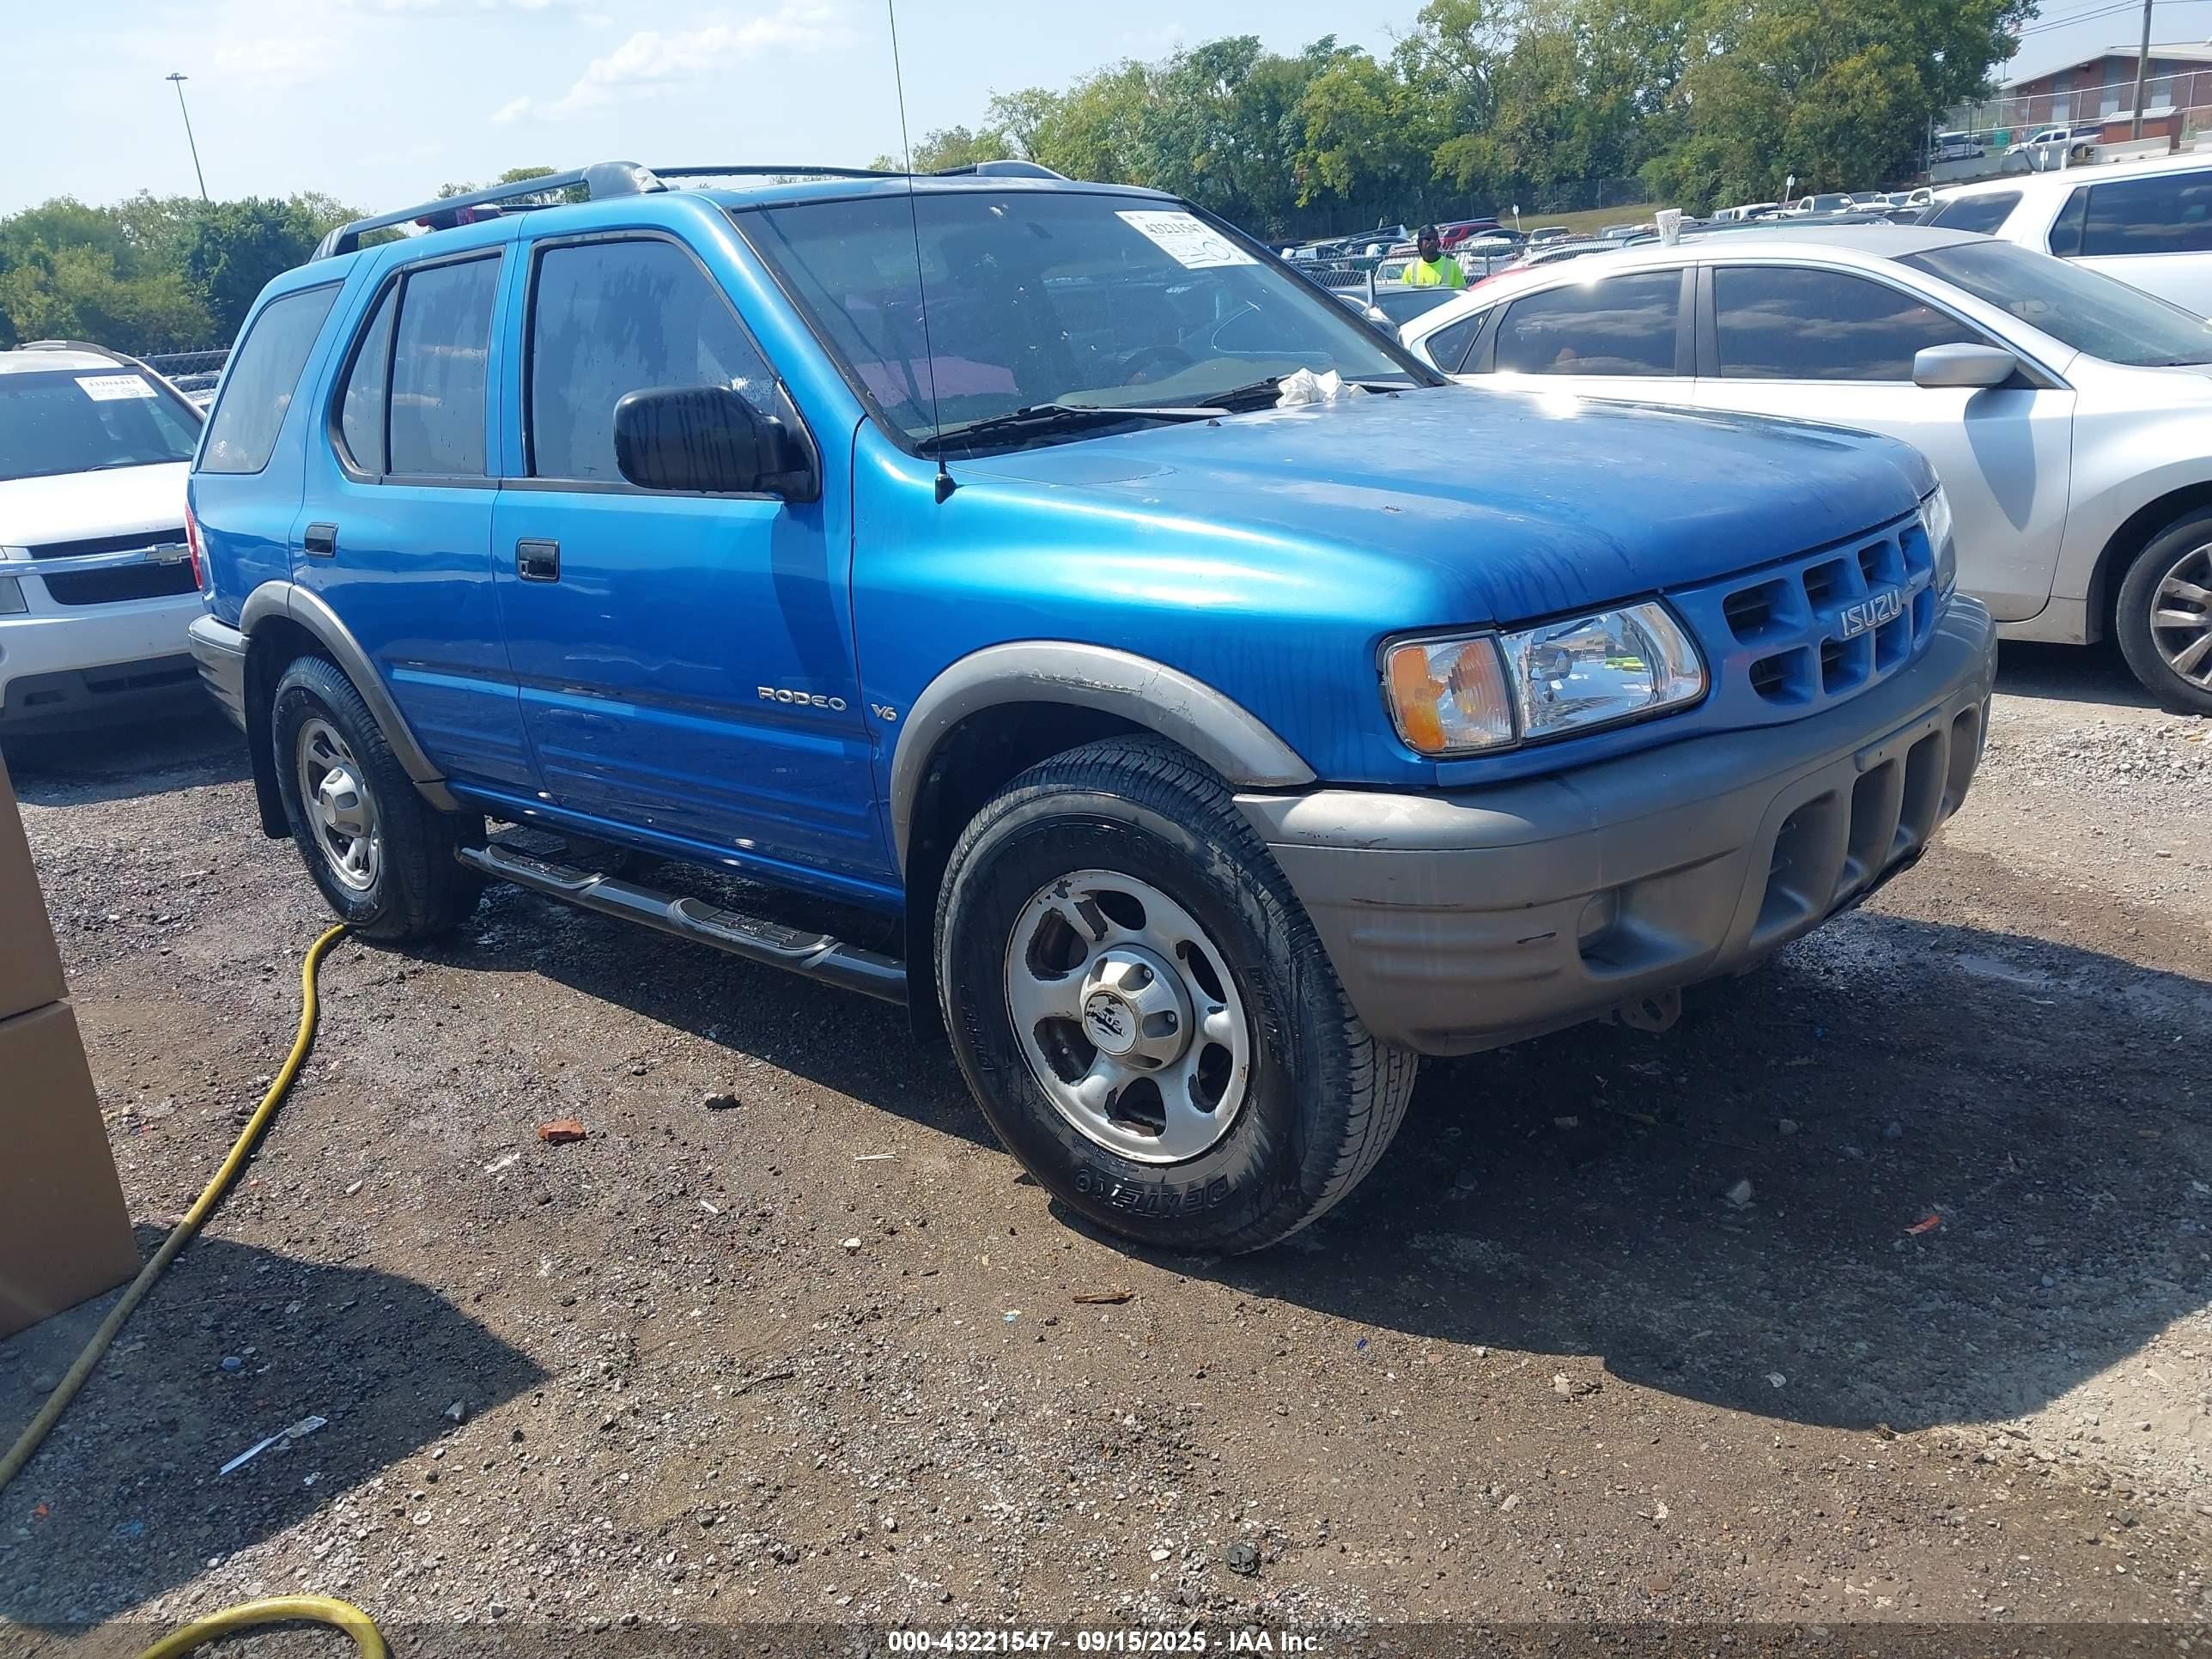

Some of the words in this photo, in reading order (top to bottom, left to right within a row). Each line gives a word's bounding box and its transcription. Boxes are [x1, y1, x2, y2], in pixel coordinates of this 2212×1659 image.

[1145, 222, 1206, 234] 43221547
[1840, 589, 1903, 636] ISUZU
[757, 686, 847, 712] RODEO
[870, 703, 898, 722] V6
[1073, 1169, 1229, 1218] DEXTERO
